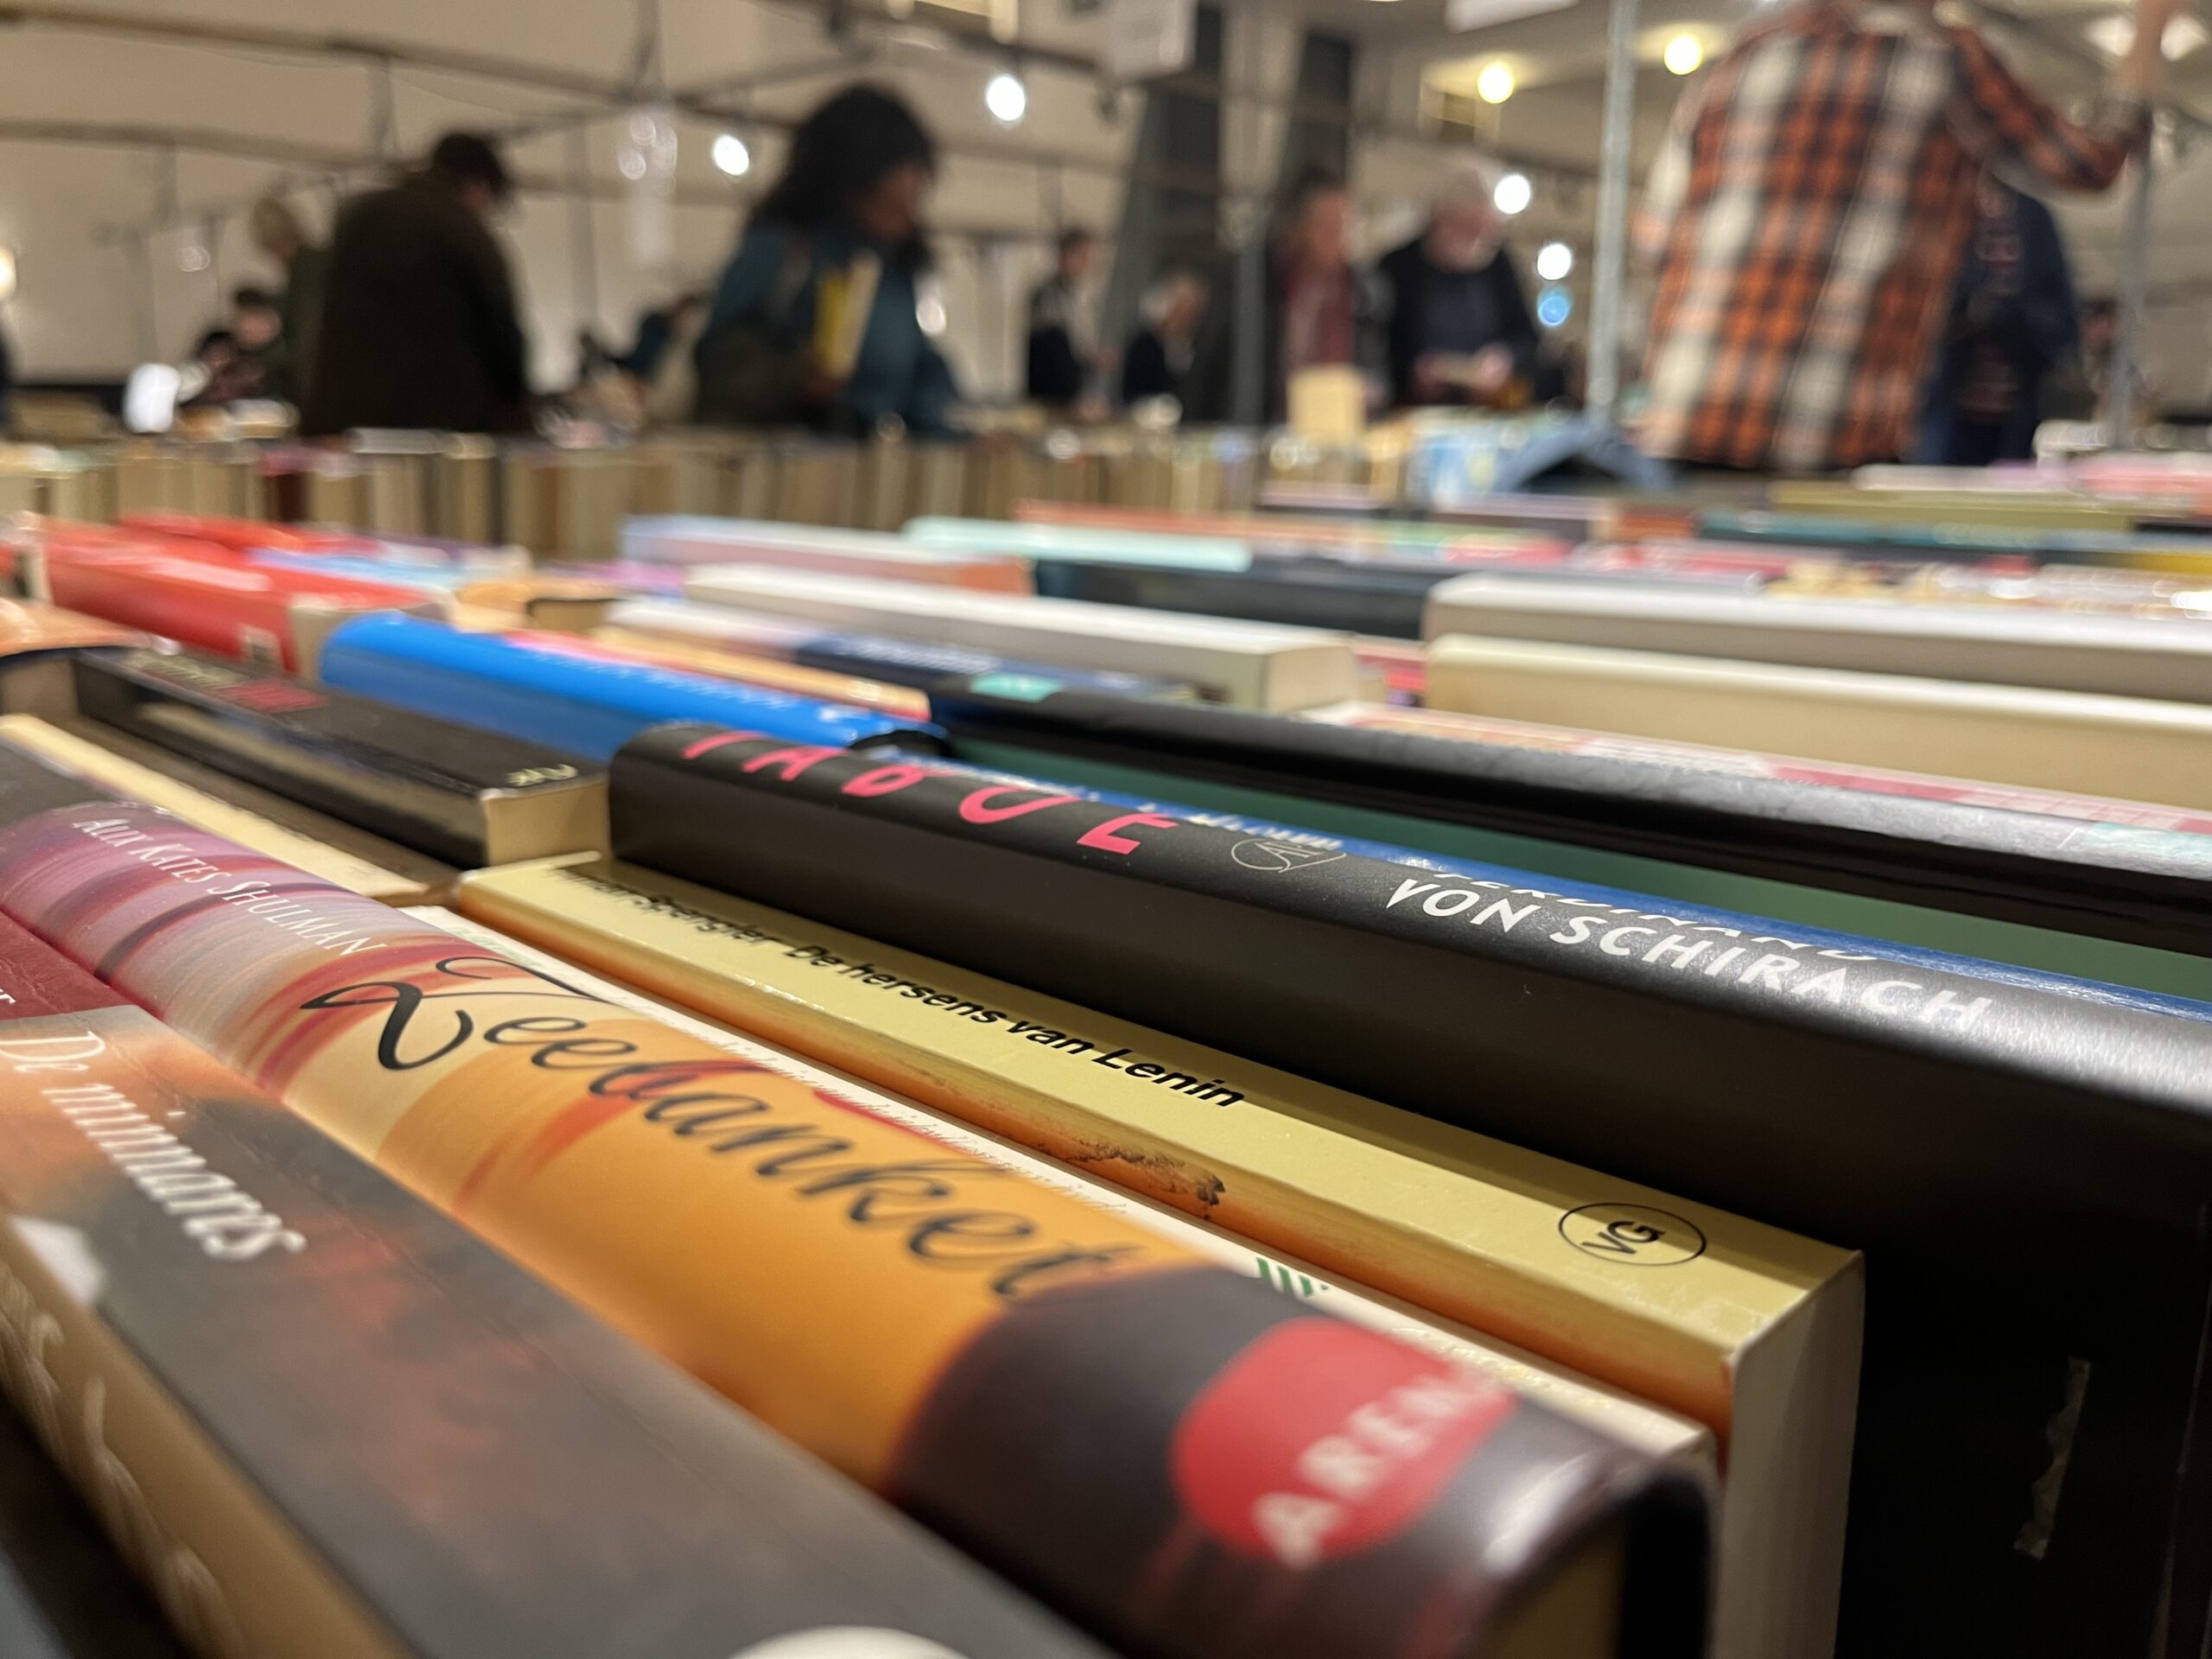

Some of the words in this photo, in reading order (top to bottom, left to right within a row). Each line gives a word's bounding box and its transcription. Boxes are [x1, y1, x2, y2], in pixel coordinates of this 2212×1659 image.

[129, 842, 232, 884] KATES
[207, 880, 387, 957] SHULMAN
[1386, 878, 1541, 933] VON
[1550, 914, 1993, 1027] SCHIRACH
[0, 1030, 105, 1073] De
[785, 944, 842, 969] De
[841, 962, 1007, 1025] hersens
[1006, 1019, 1095, 1056] van
[1091, 1047, 1246, 1108] Lenin
